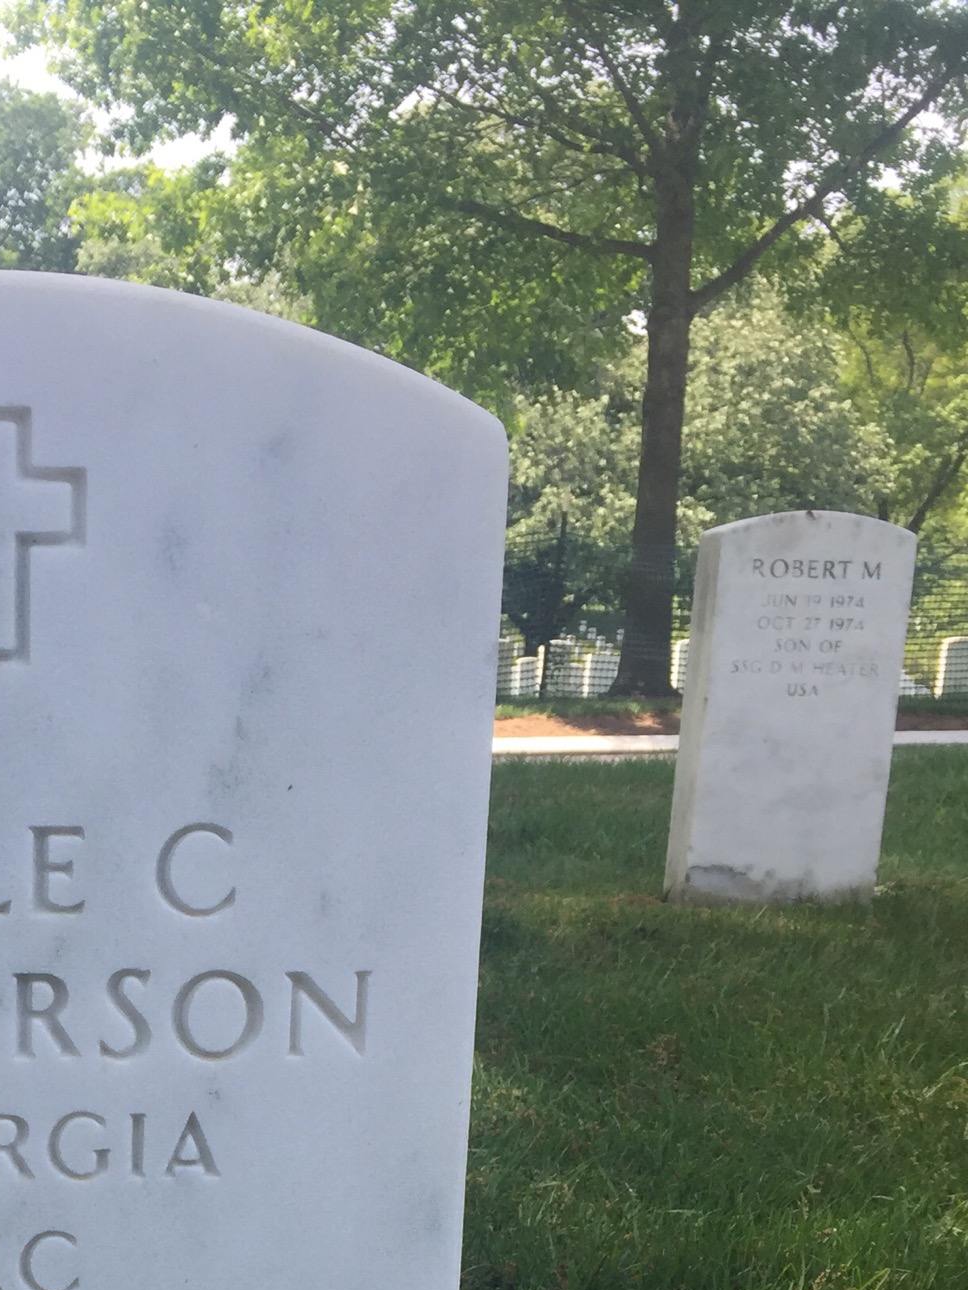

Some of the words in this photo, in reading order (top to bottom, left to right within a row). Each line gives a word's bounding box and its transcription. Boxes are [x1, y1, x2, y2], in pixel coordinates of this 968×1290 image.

[752, 558, 853, 580] ROBERT
[861, 560, 883, 580] M
[761, 594, 798, 608] JUN
[806, 594, 822, 607] 19
[830, 594, 865, 608] 1974
[756, 616, 796, 630] OCT
[803, 617, 821, 630] 27
[829, 617, 865, 631] 1974
[774, 638, 811, 652] SON
[819, 639, 843, 654] OF
[730, 659, 762, 674] SSG
[769, 660, 782, 674] D
[790, 660, 804, 674] M
[812, 661, 880, 677] HEATER
[786, 683, 820, 697] USA
[155, 822, 238, 917] C
